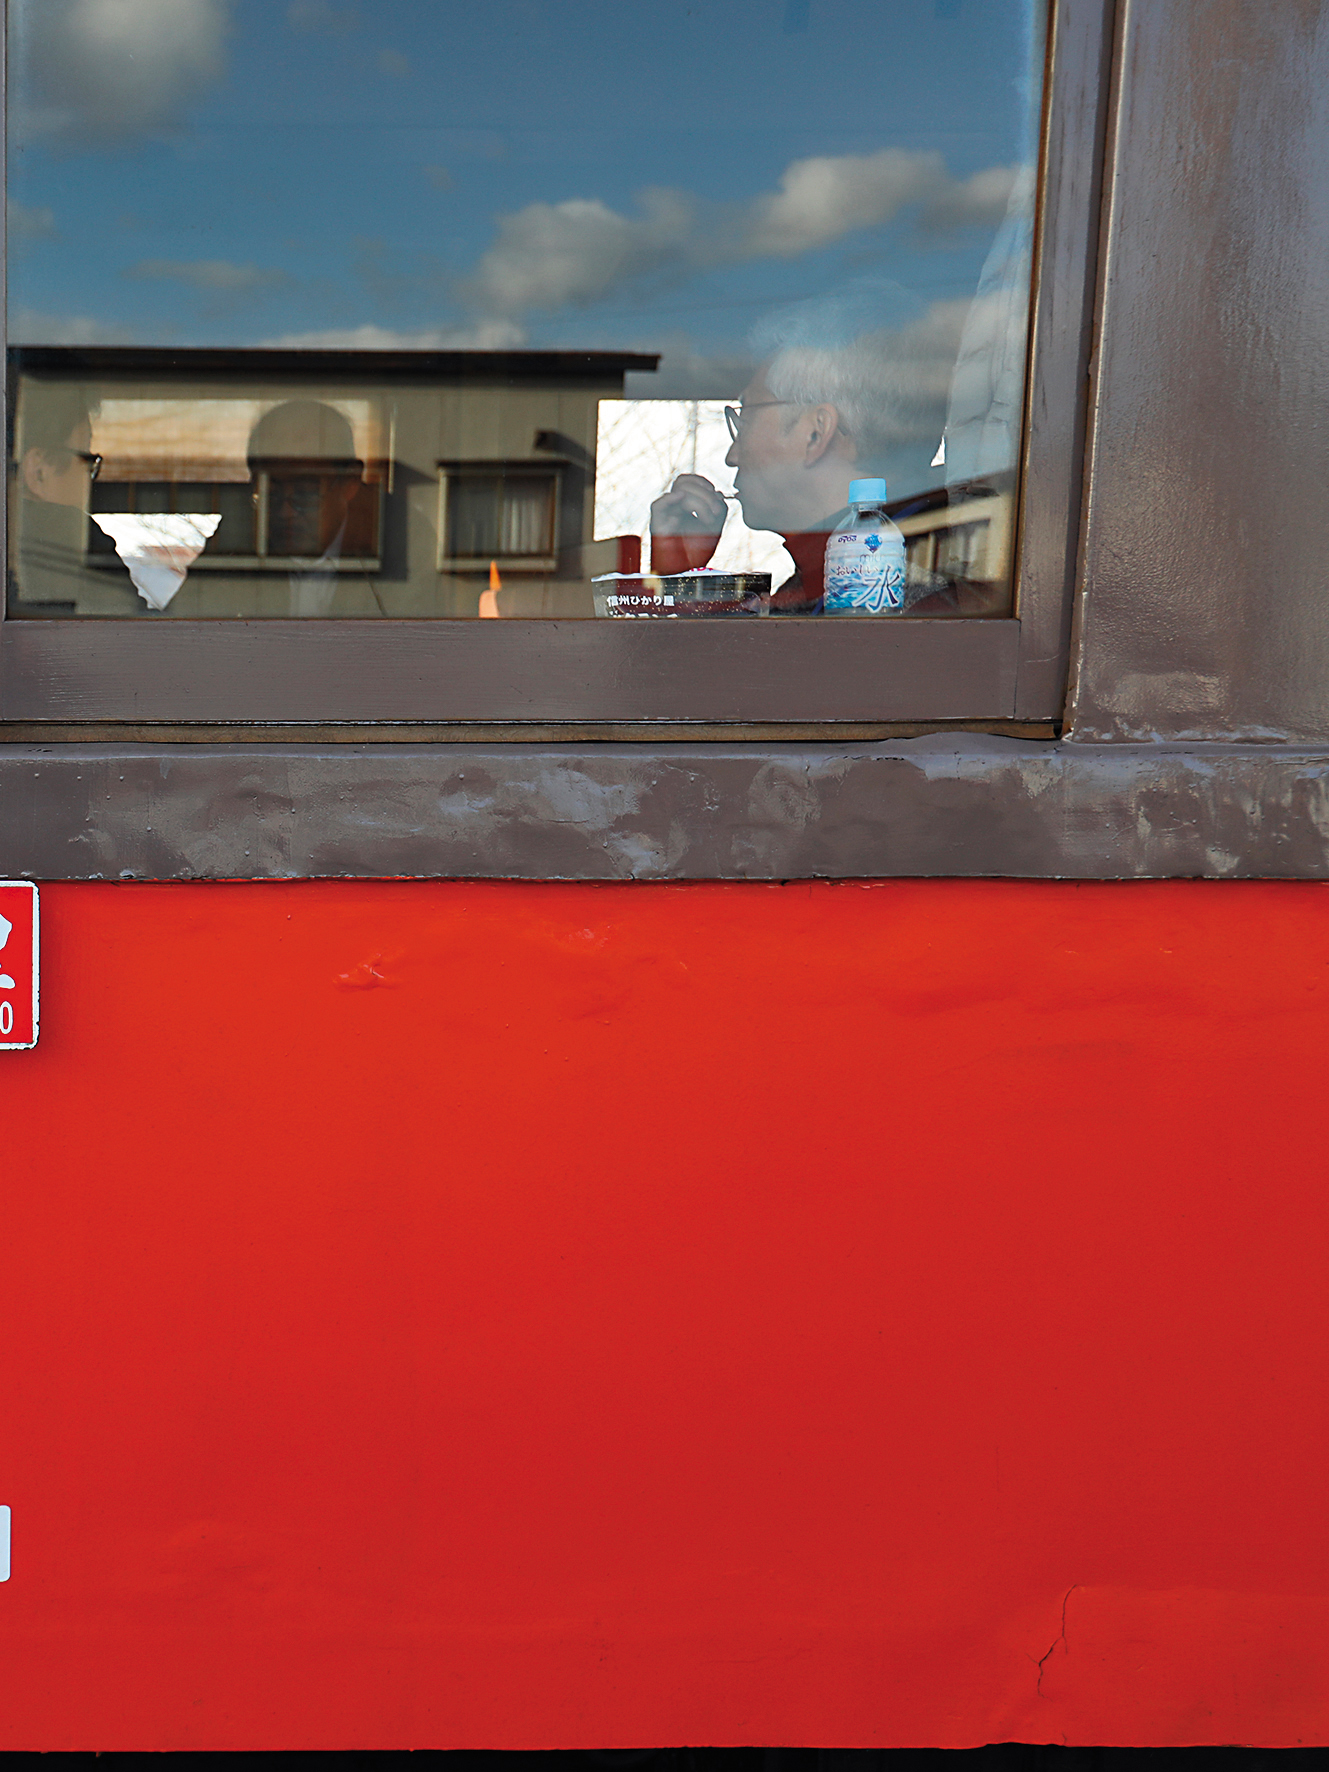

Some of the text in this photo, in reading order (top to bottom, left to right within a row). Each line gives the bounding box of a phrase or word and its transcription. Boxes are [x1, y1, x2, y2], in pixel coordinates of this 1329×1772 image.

[606, 595, 675, 607] 信州ひかり屋
[852, 564, 901, 613] 水
